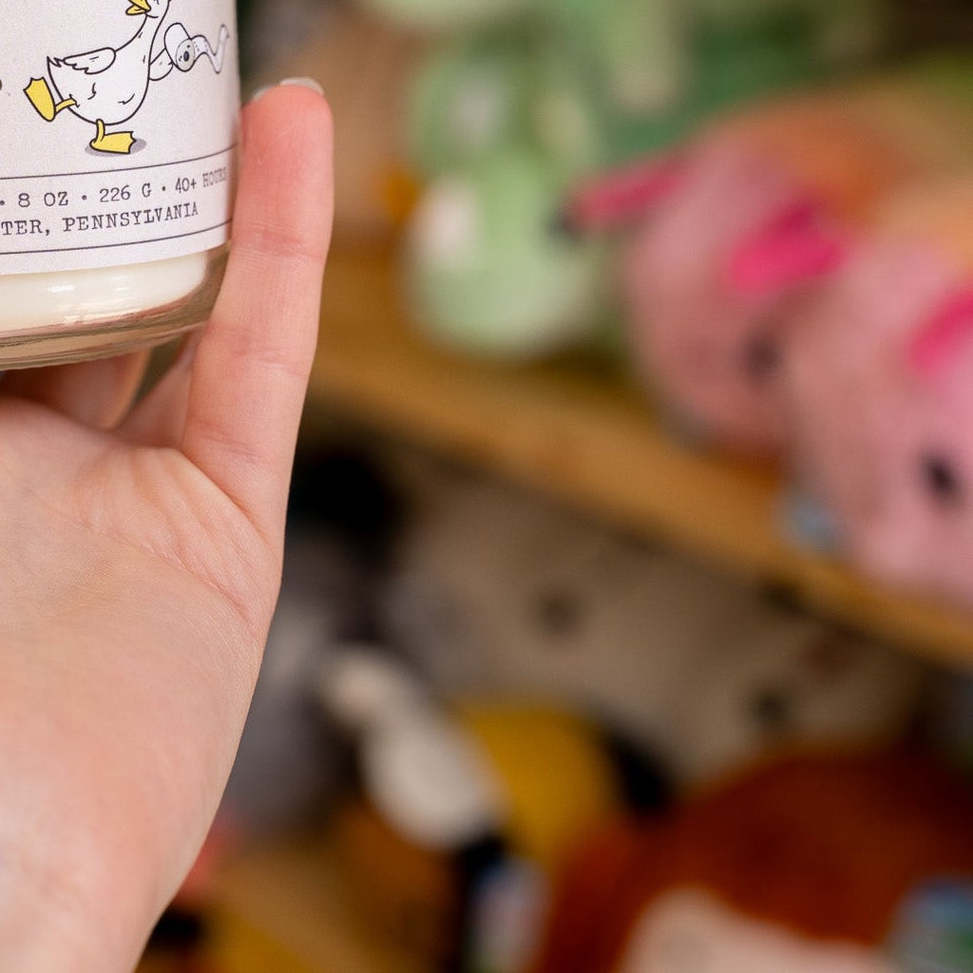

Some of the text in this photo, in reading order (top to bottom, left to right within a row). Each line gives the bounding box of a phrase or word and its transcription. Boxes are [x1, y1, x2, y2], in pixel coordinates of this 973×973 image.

[18, 193, 31, 208] 8
[43, 192, 70, 207] OZ
[99, 185, 132, 203] 226
[141, 183, 152, 198] G
[175, 177, 197, 194] 40+
[62, 201, 199, 232] PENNSYLVANIA
